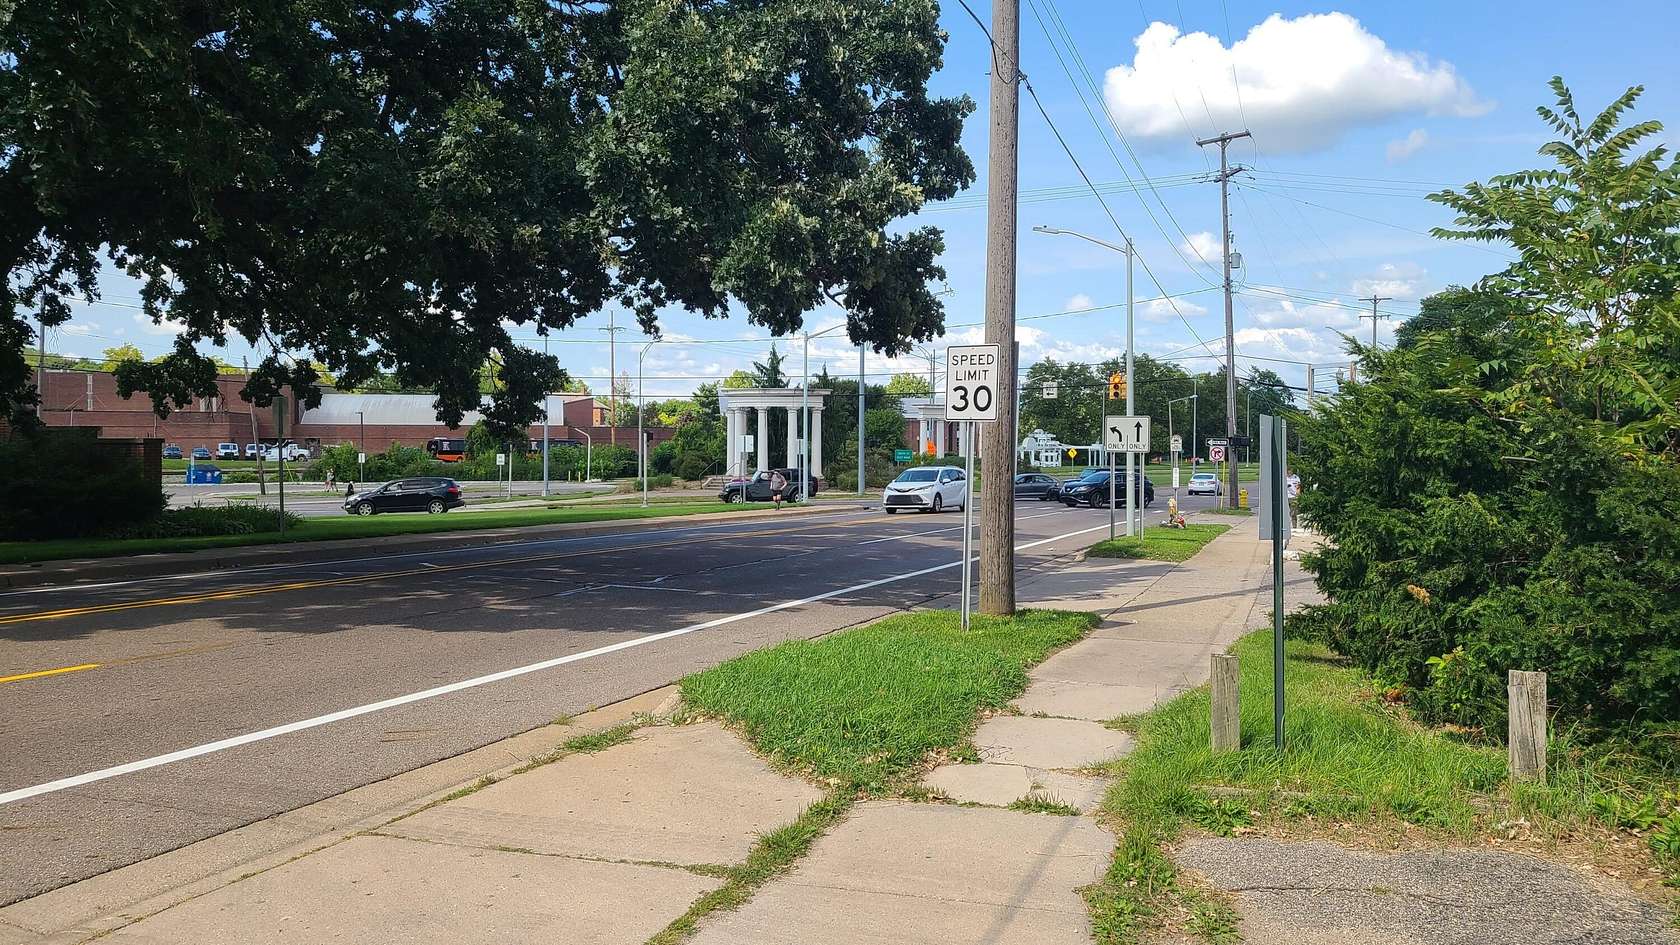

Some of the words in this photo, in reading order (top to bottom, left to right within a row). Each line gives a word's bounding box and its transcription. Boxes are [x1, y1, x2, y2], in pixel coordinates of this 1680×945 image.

[952, 354, 995, 366] SPEED
[955, 370, 989, 381] LIMIT
[951, 385, 992, 412] 30
